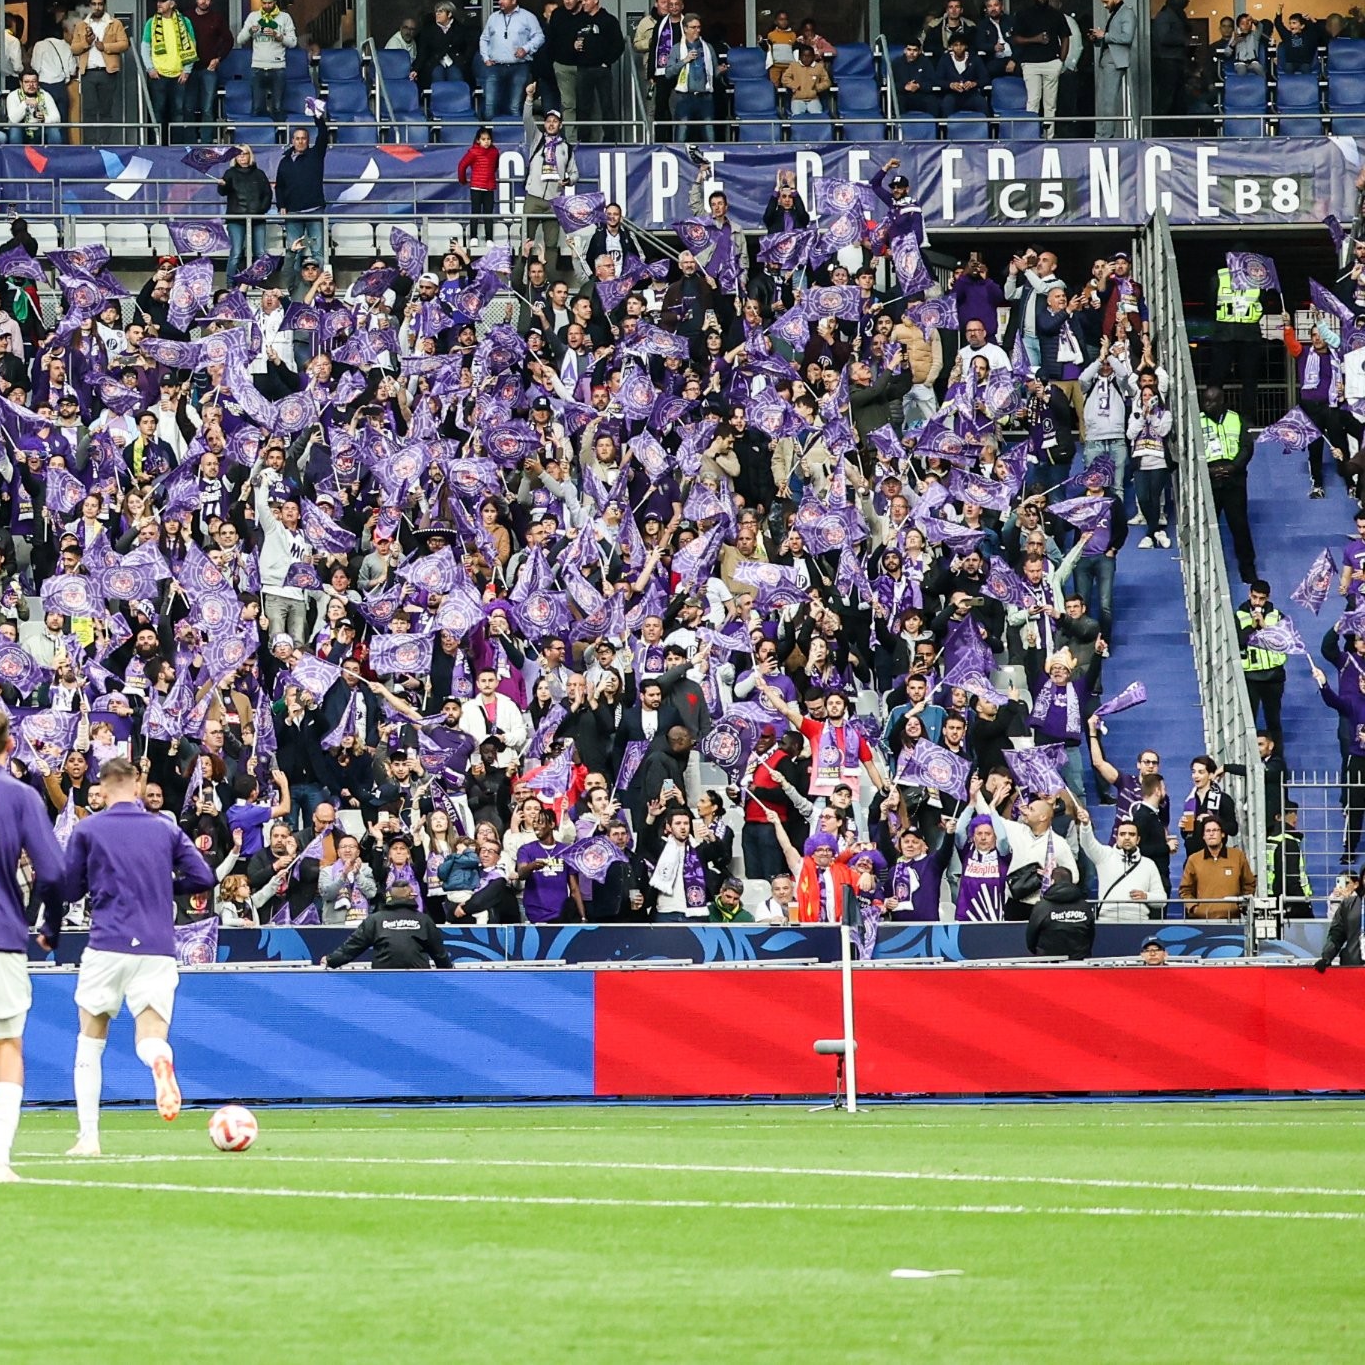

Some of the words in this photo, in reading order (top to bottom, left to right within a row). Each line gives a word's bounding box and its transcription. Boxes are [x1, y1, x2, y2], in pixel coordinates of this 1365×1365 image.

[497, 150, 726, 226] CUPE
[441, 794, 460, 823] VIOLETS
[382, 919, 421, 931] Gest'SPORT
[1050, 910, 1088, 924] Gest'SPORT
